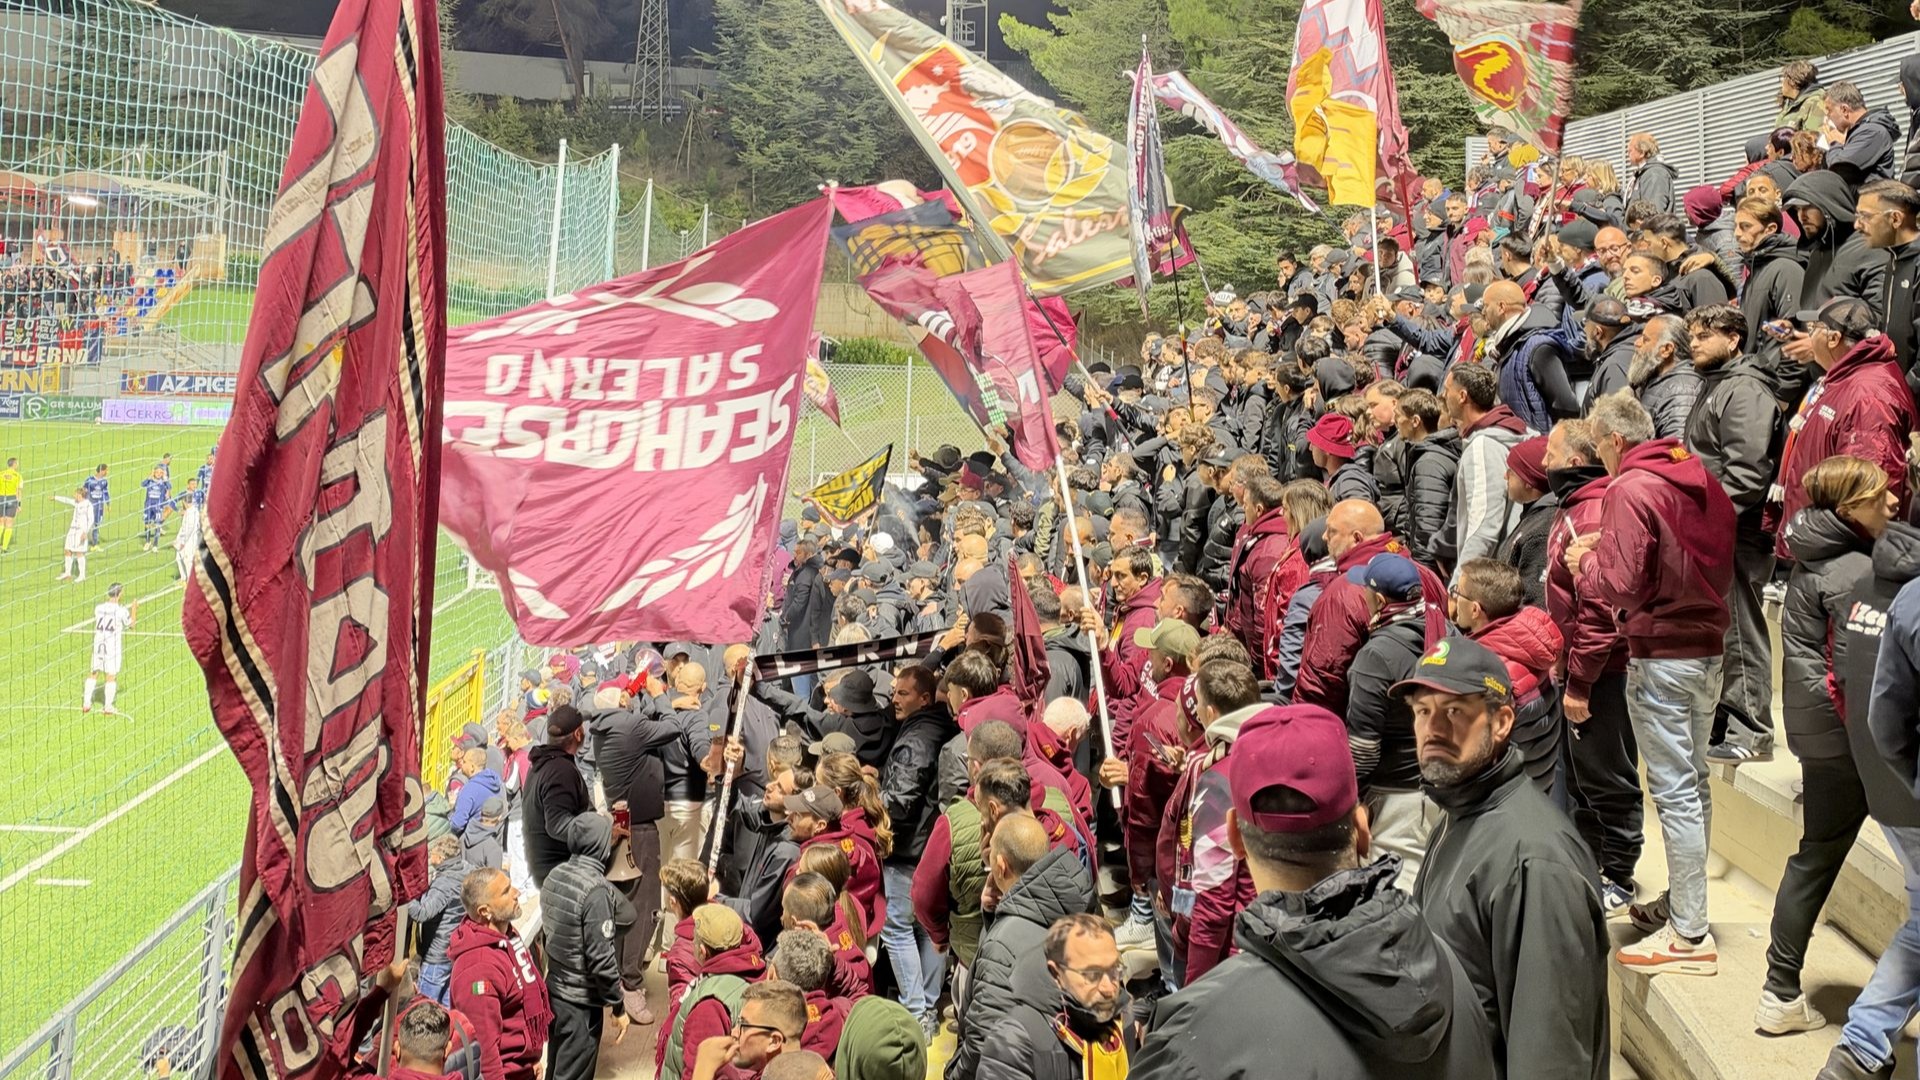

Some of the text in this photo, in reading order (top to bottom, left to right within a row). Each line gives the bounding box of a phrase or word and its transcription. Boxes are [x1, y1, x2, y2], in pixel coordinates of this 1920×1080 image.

[486, 344, 763, 401] SALERNO
[160, 376, 190, 392] AZ
[110, 409, 120, 418] IL
[443, 372, 798, 472] SEAHORSE
[96, 617, 115, 632] 44
